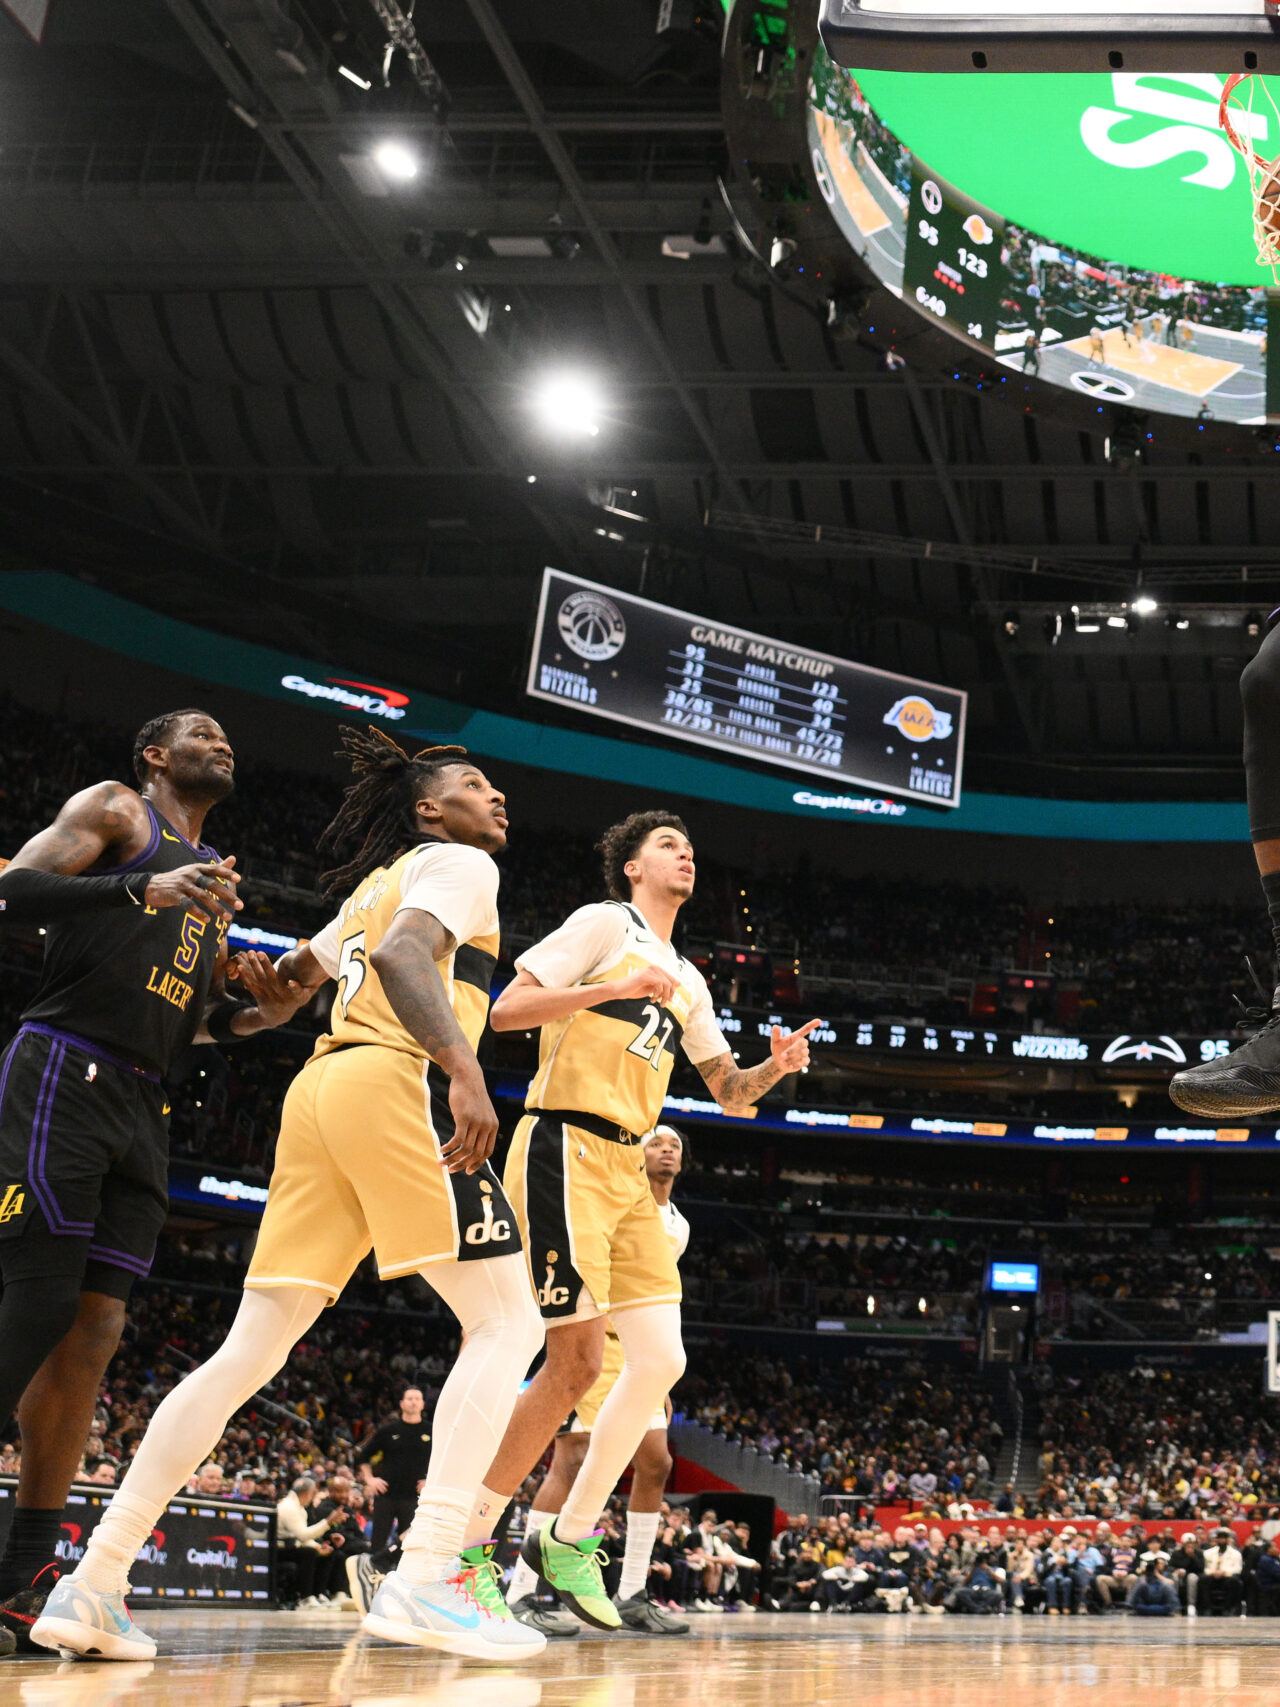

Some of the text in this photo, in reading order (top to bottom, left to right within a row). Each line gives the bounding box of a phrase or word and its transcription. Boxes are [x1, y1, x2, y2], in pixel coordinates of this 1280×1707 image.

[918, 219, 939, 246] 95
[957, 248, 988, 278] 123
[916, 286, 946, 317] 6:40
[691, 625, 834, 678] GAME MATCHUP
[686, 644, 706, 661] 95
[811, 681, 839, 699] 123
[680, 677, 702, 694] 25
[811, 714, 832, 731] 34
[812, 698, 834, 714] 40
[664, 708, 712, 731] 12/39
[796, 727, 843, 749] 45/73
[173, 912, 206, 974] 5
[338, 930, 366, 1021] 5
[626, 1004, 674, 1072] 21
[856, 1032, 872, 1045] 25
[889, 1035, 906, 1047] 37
[923, 1037, 938, 1050] 16
[956, 1040, 965, 1052] 2
[986, 1042, 994, 1053] 1
[1013, 1041, 1088, 1060] WIZARDS
[1200, 1040, 1231, 1061] 95
